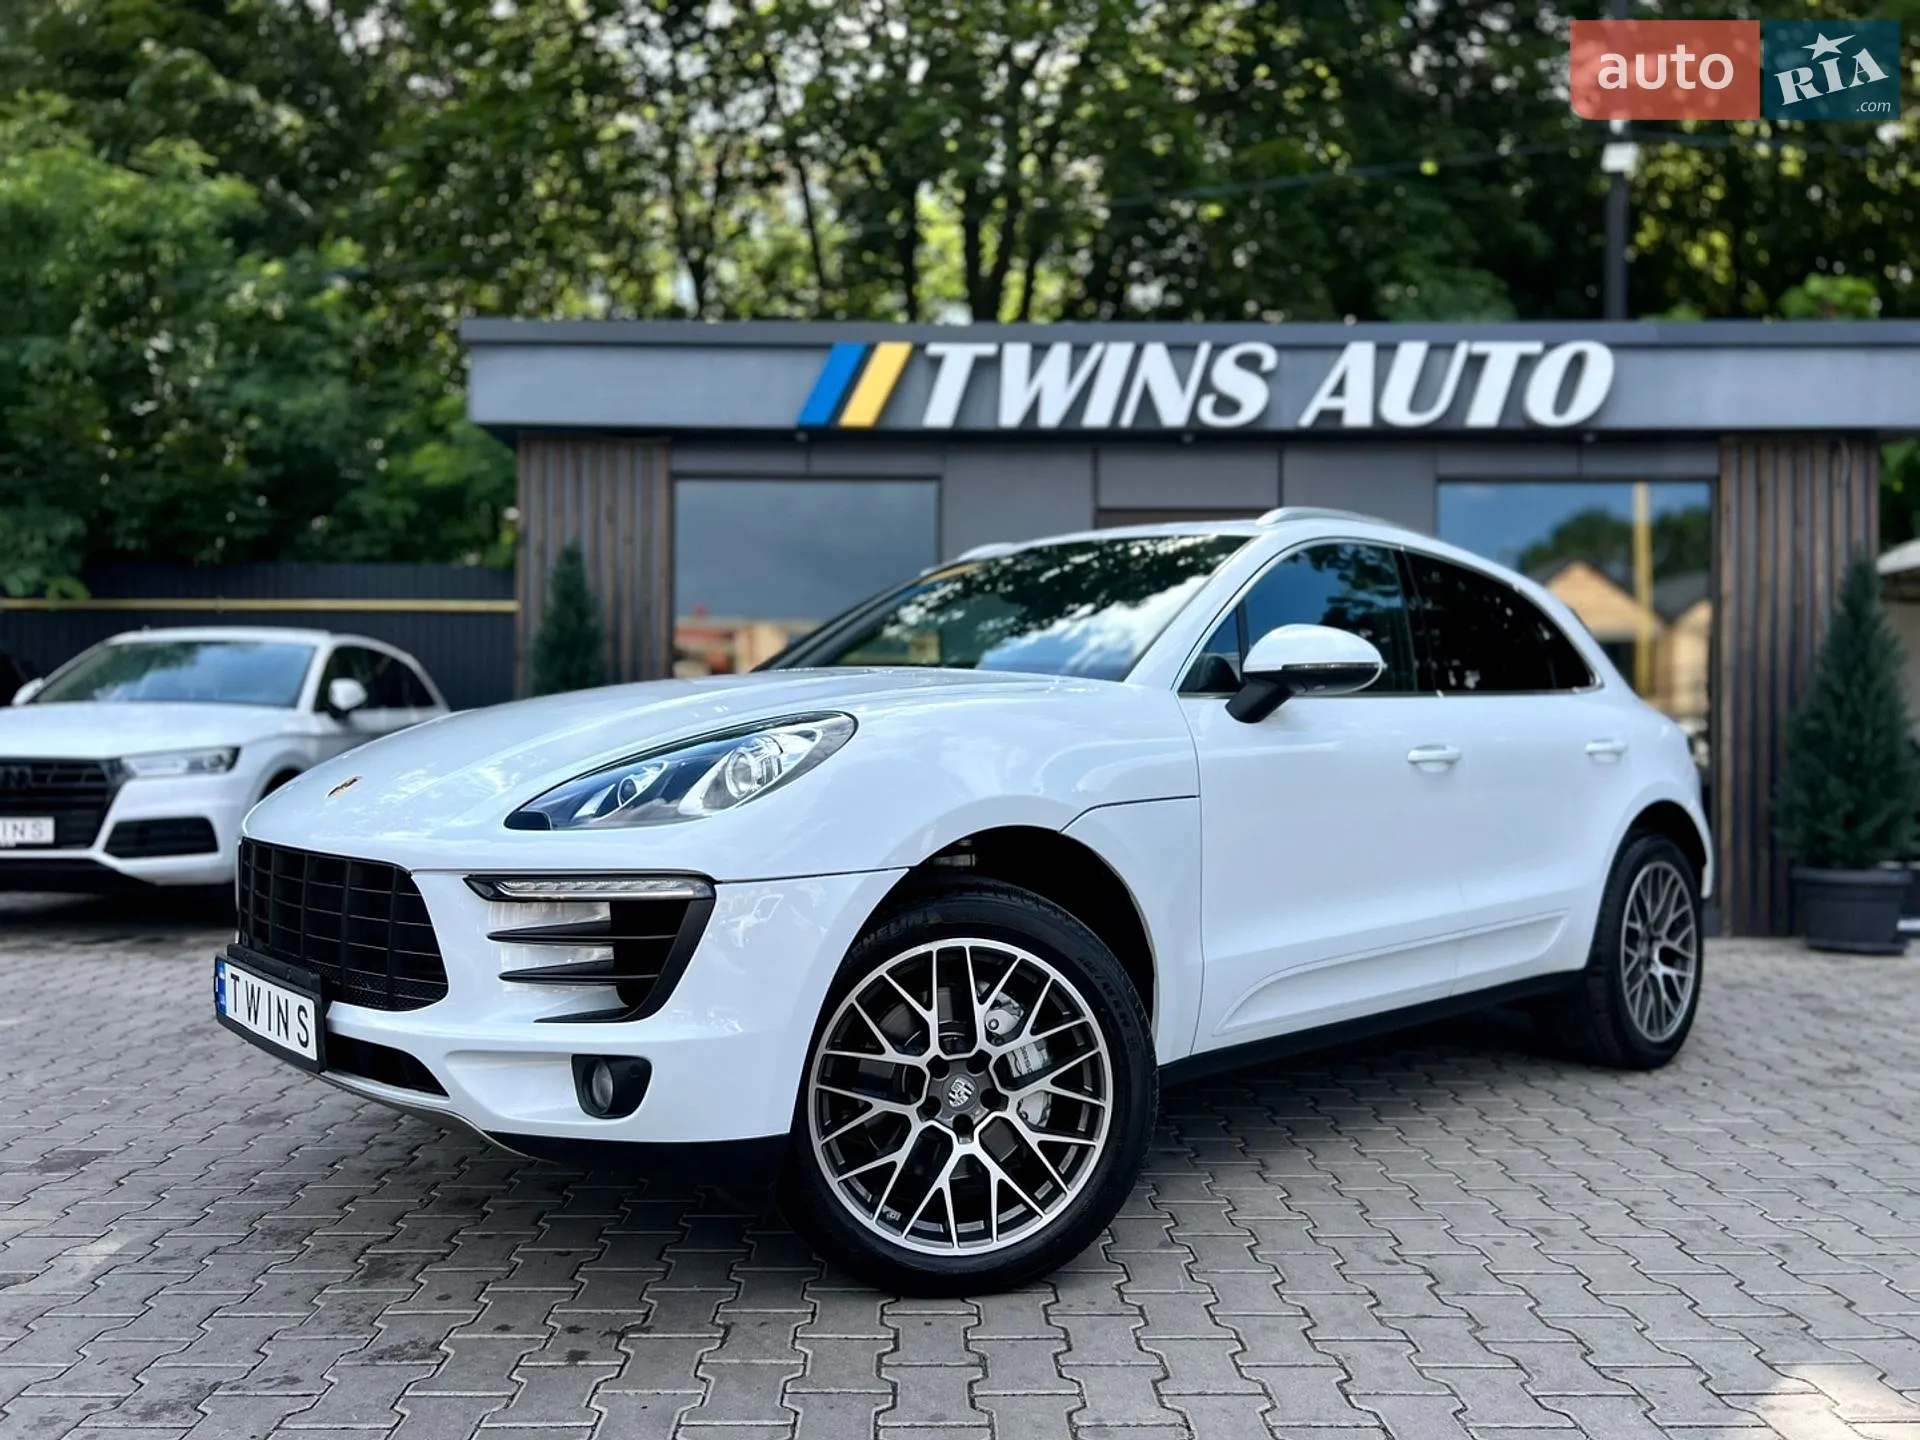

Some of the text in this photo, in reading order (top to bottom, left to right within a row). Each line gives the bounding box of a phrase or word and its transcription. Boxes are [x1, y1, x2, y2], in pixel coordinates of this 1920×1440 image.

[922, 340, 1615, 428] TWINS AUTO
[230, 972, 309, 1048] TWINS
